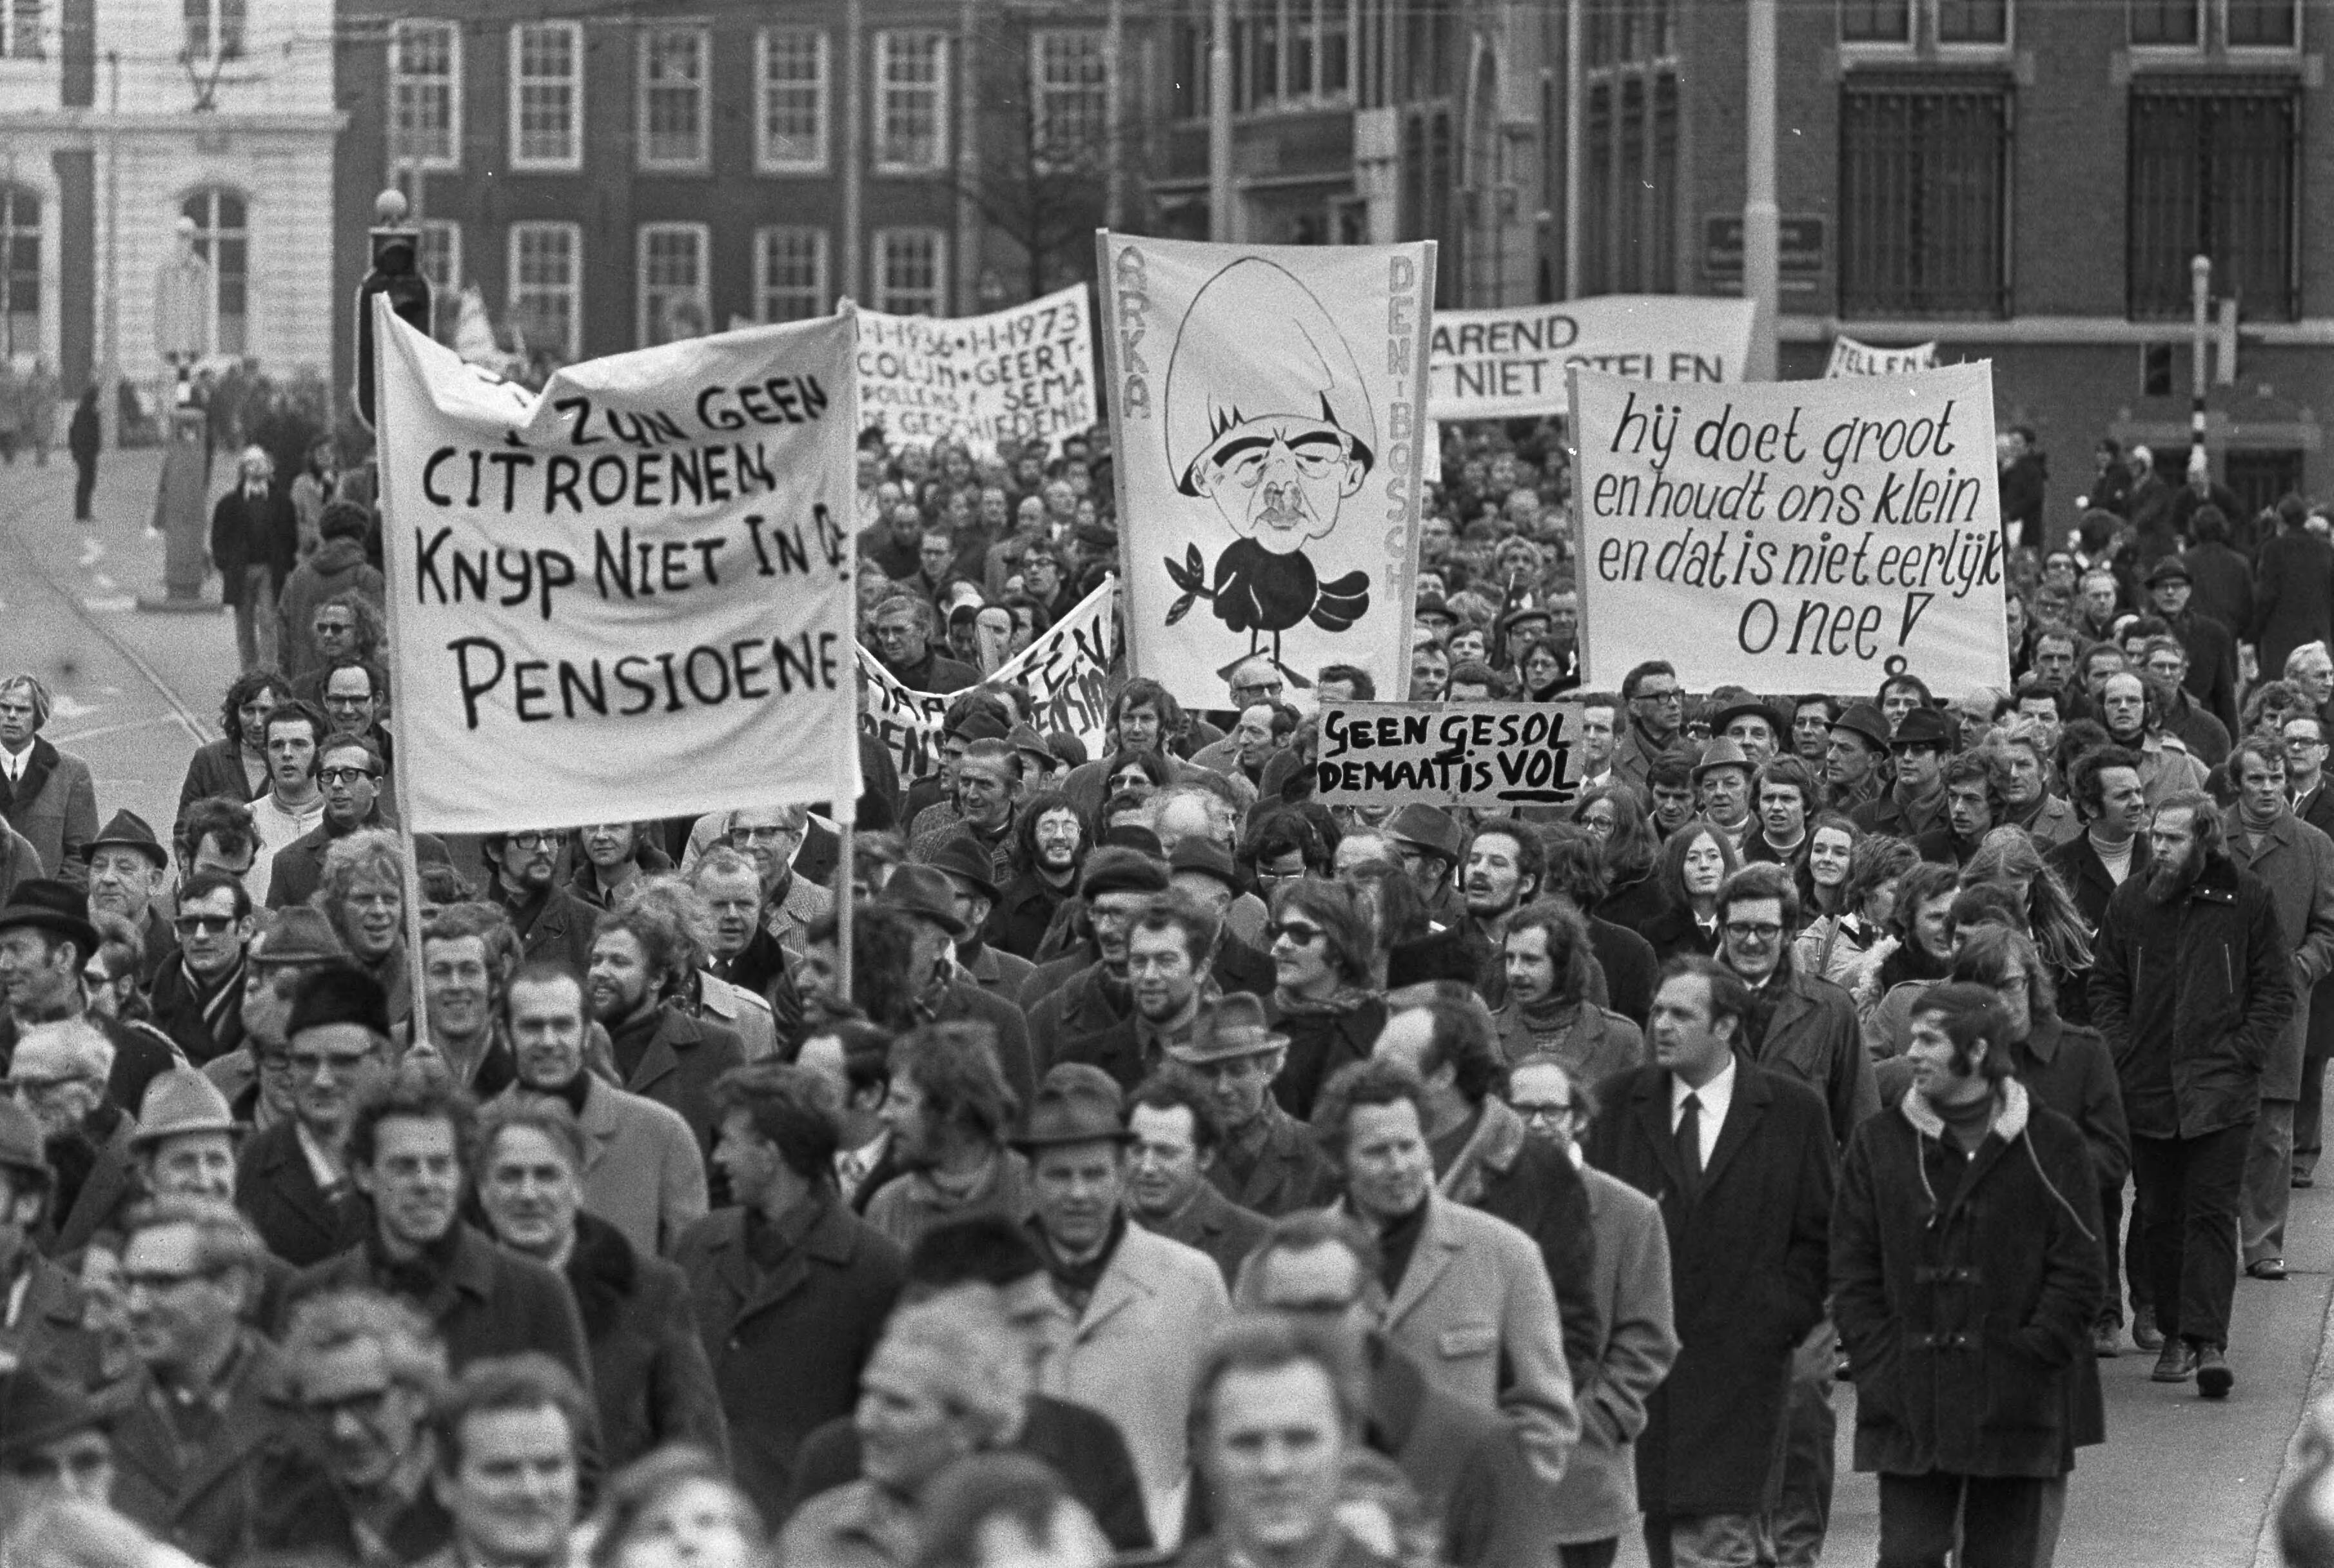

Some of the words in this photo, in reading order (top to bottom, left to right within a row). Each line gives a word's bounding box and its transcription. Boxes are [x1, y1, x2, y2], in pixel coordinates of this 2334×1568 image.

[1431, 315, 1578, 355] AREND
[696, 374, 829, 430] GEEN
[1003, 366, 1084, 411] SEMA
[1453, 358, 1549, 398] NIET
[1610, 393, 1682, 469] hij
[1693, 404, 1805, 463] doet
[1822, 400, 1956, 480] groot
[422, 442, 775, 514] CITROENEN
[1777, 485, 1865, 525] ons
[1871, 467, 1981, 524] klein
[594, 526, 727, 600] NIET
[744, 514, 810, 576] IN
[1325, 710, 1430, 758] GEEN
[1436, 712, 1571, 759] GESOL
[1496, 749, 1580, 790] VOL
